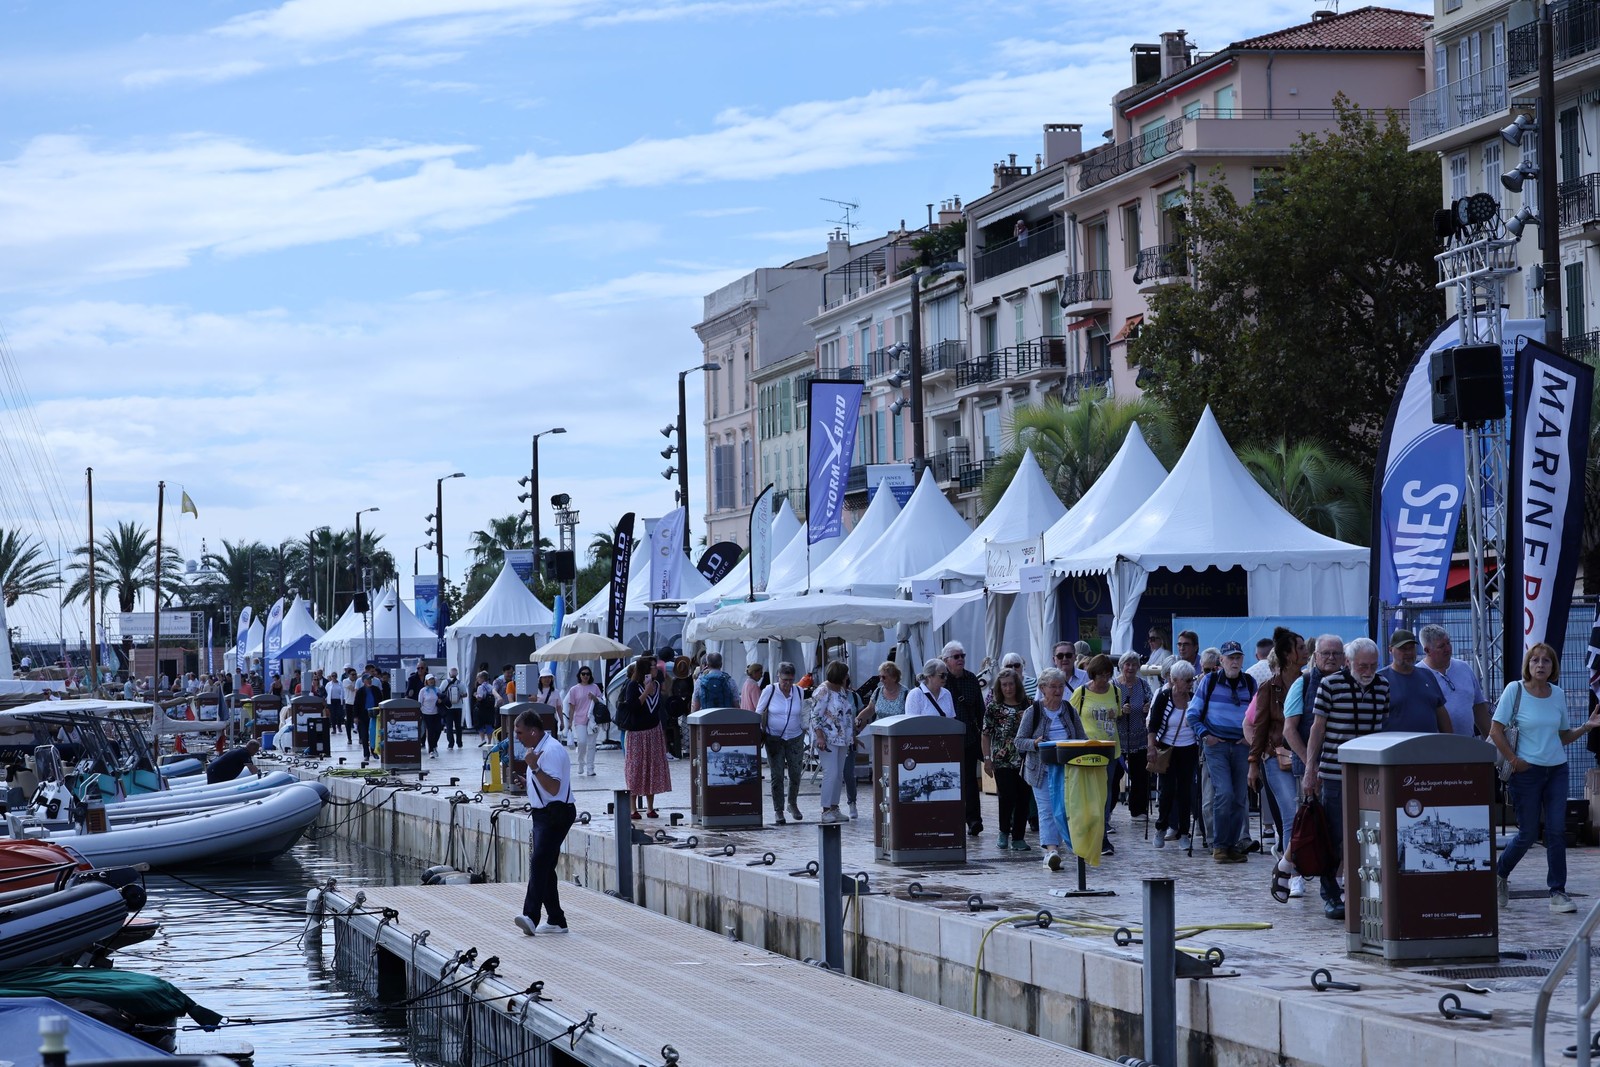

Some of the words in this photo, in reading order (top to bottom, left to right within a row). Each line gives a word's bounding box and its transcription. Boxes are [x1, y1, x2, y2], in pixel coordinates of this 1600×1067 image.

[833, 394, 847, 439] BIRD
[841, 429, 852, 488] FRANCE
[826, 462, 842, 519] STORM
[1173, 583, 1216, 600] Optic
[269, 636, 281, 678] CANES
